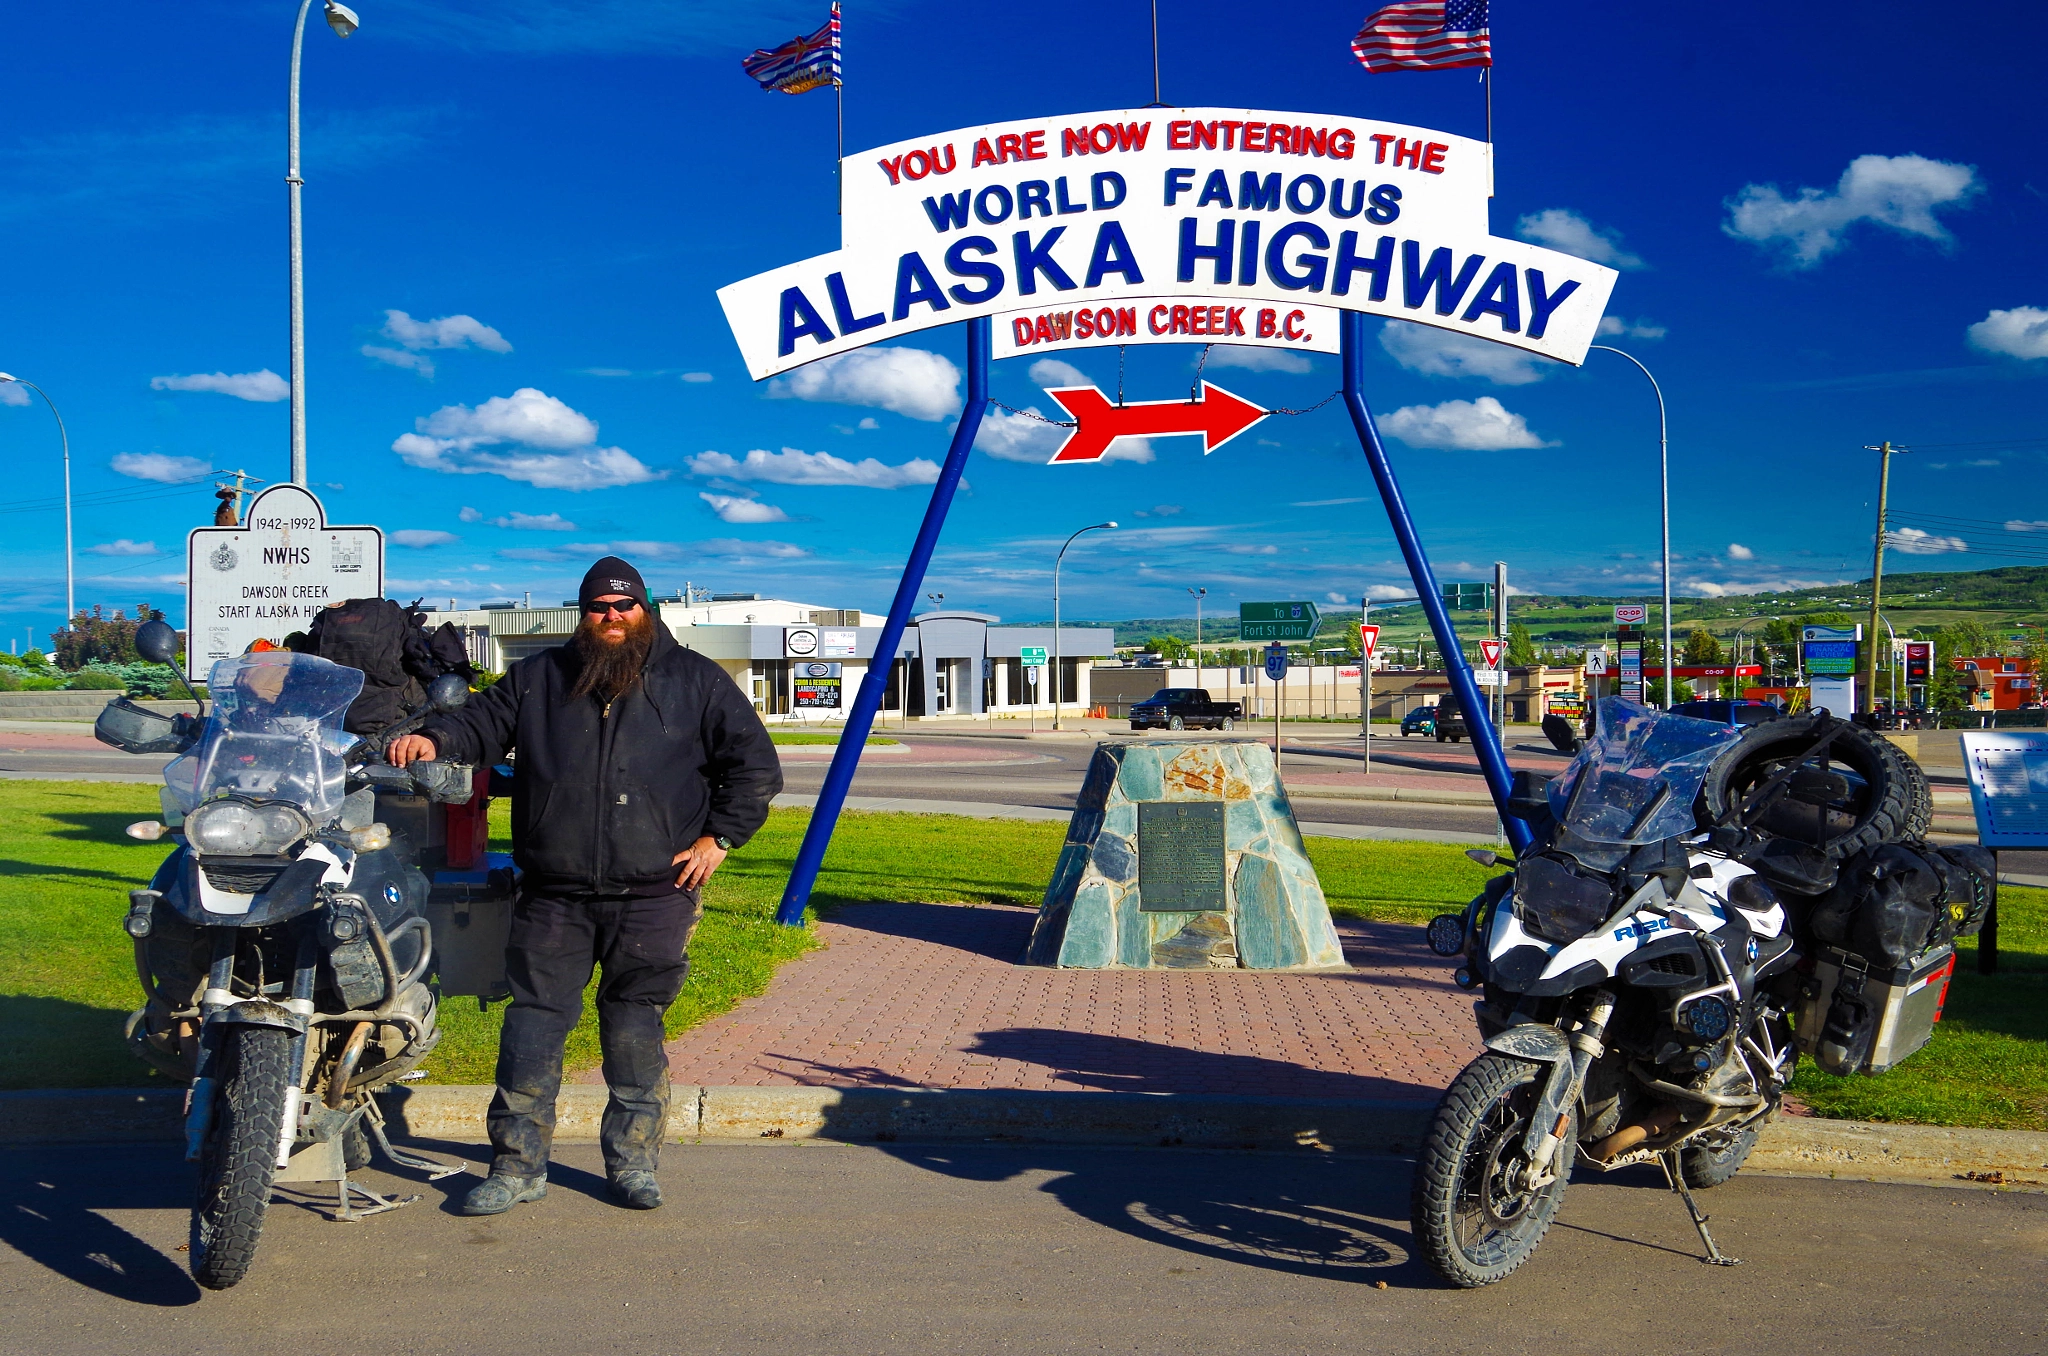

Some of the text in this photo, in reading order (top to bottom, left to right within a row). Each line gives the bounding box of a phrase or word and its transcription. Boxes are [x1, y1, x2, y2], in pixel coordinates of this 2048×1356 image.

[878, 120, 1449, 187] YOU ARE NOW ENTERING THE
[921, 167, 1402, 233] WORLD FAMOUS
[778, 217, 1581, 357] ALASKA HIGHWAY
[1011, 304, 1313, 348] DAWSON CREEK B.C.
[256, 518, 316, 530] 1942-1992
[263, 547, 310, 564] NWHS
[242, 585, 329, 599] DAWSON CREEK
[218, 605, 251, 618] START
[255, 605, 299, 618] ALASKA
[1274, 608, 1301, 619] To 97
[1244, 625, 1303, 636] Fort St John
[1267, 656, 1284, 671] 97
